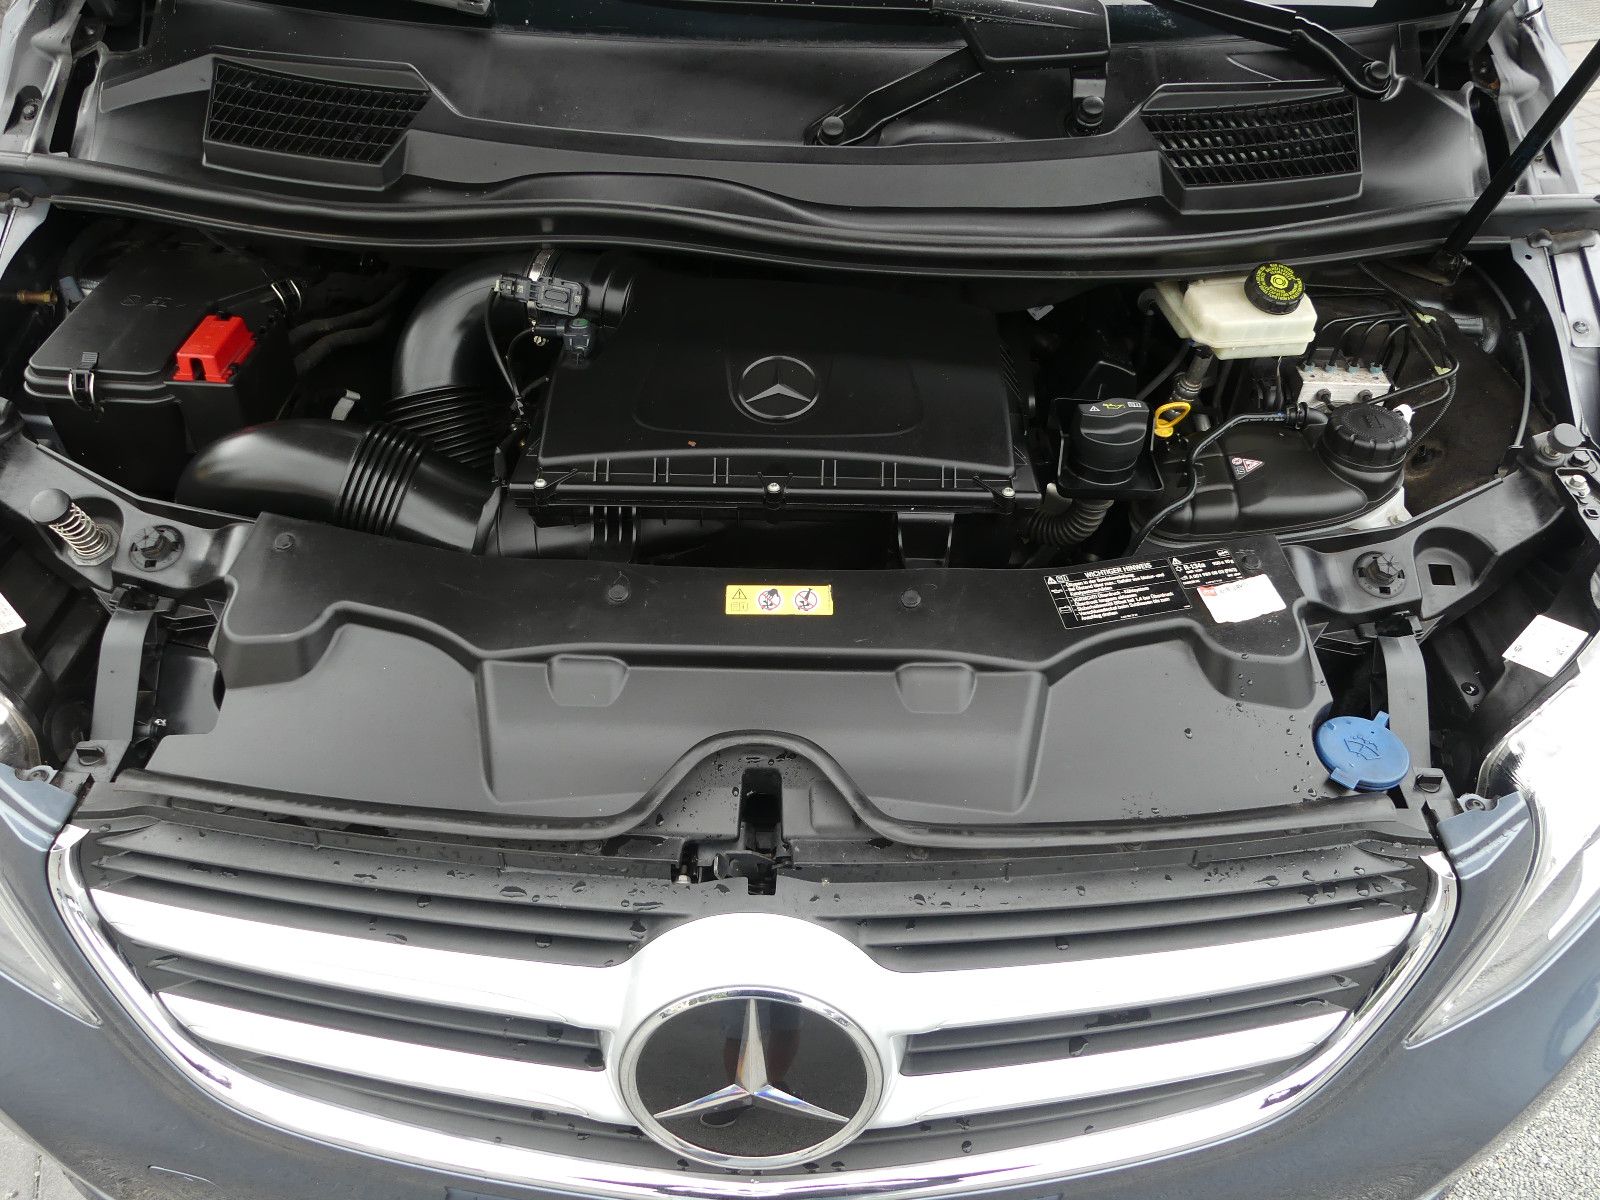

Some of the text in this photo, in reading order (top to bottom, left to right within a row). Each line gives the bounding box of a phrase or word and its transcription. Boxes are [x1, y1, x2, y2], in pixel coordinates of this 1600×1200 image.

[1084, 567, 1123, 578] WICHTIGER
[1123, 563, 1152, 572] HINWEIS
[1183, 562, 1206, 570] R-134a
